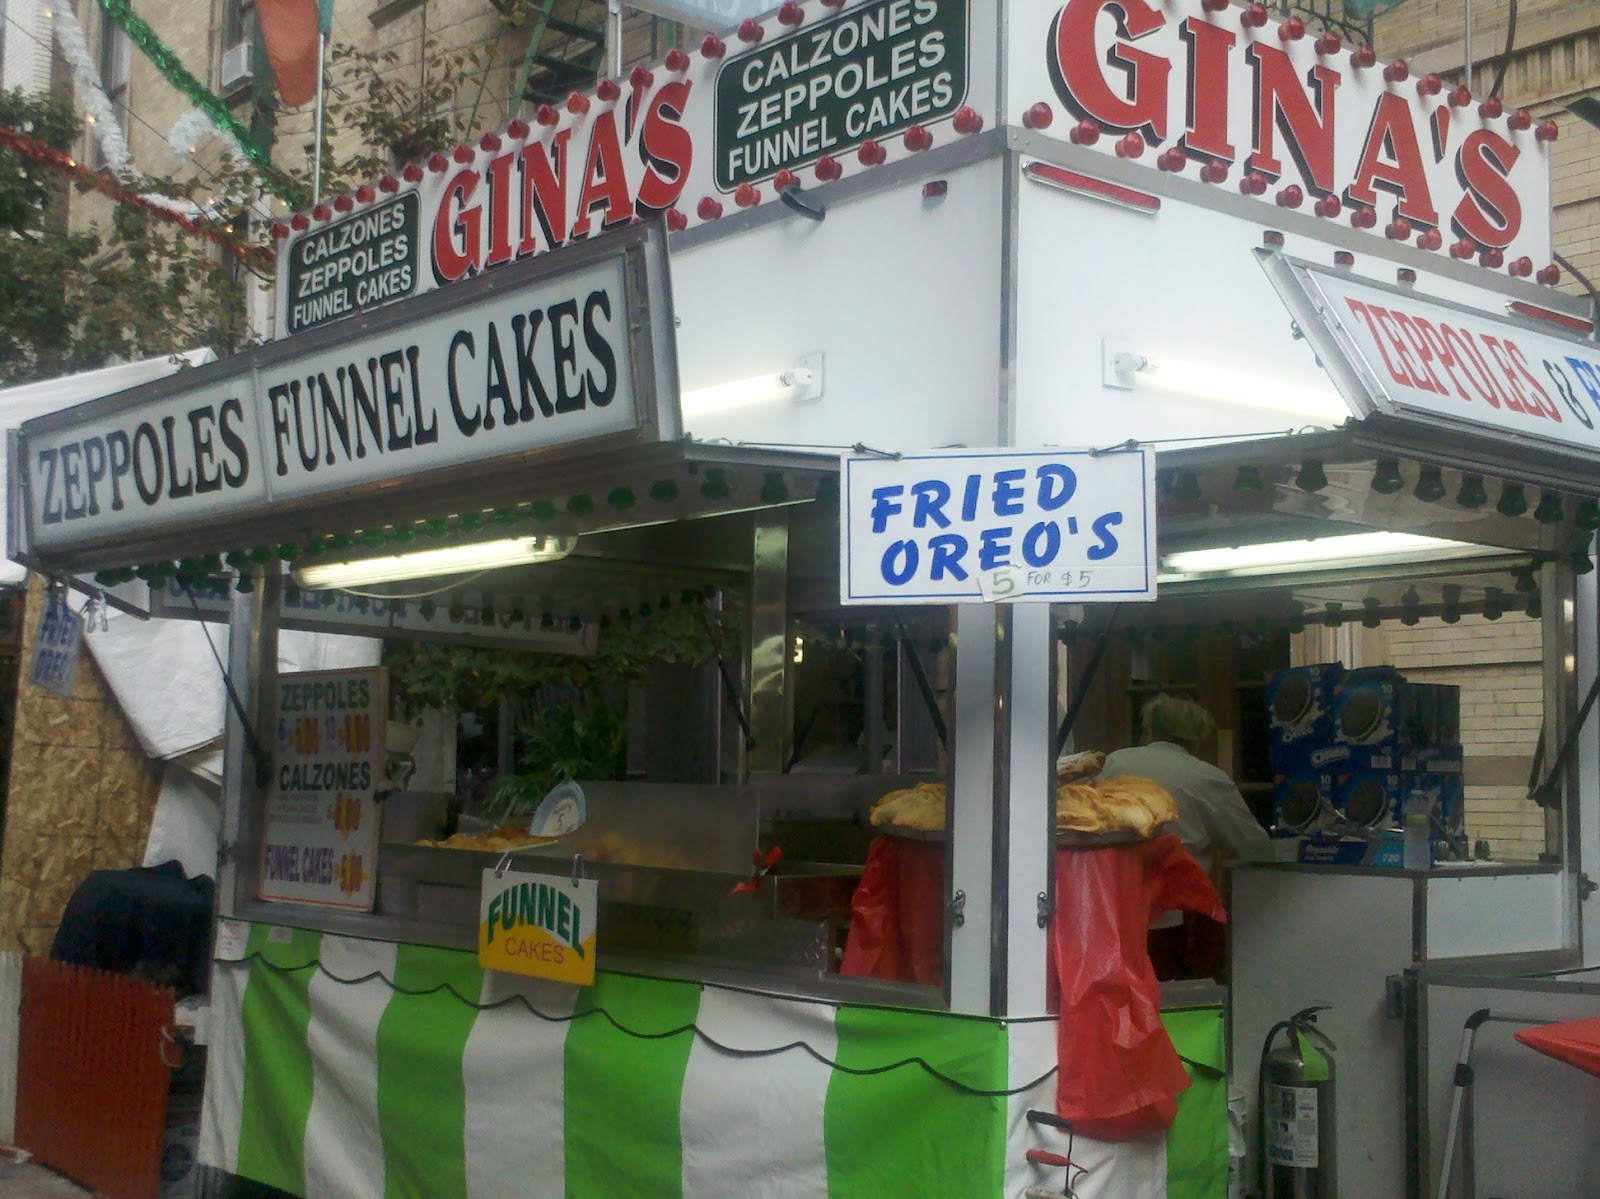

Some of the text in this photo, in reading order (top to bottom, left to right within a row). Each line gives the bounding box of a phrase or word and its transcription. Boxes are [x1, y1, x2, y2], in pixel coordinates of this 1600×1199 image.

[742, 0, 939, 94] CALZONES
[736, 30, 946, 140] ZEPPOLES
[728, 71, 953, 182] FUNNEL CAKES
[1046, 0, 1522, 253] GINA'S
[431, 79, 693, 288] GINA'S
[298, 234, 409, 298] ZEPPOLES
[302, 203, 405, 266] CALZONES
[293, 264, 412, 330] FUNNEL CAKES
[1344, 296, 1562, 423] ZEPPOLES
[38, 289, 618, 525] ZEPPOLES FUNNEL CAKES
[870, 463, 1077, 534] FRIED
[880, 511, 1123, 586] OREO'S
[991, 570, 1015, 595] 5
[1026, 571, 1052, 587] FOR
[281, 679, 370, 711] ZEPPOLES
[1381, 684, 1393, 693] 10
[279, 761, 371, 791] CALZONES
[1320, 775, 1331, 784] 10
[1386, 775, 1397, 785] 10
[487, 882, 585, 960] FUNNEL
[504, 937, 565, 964] CAKES
